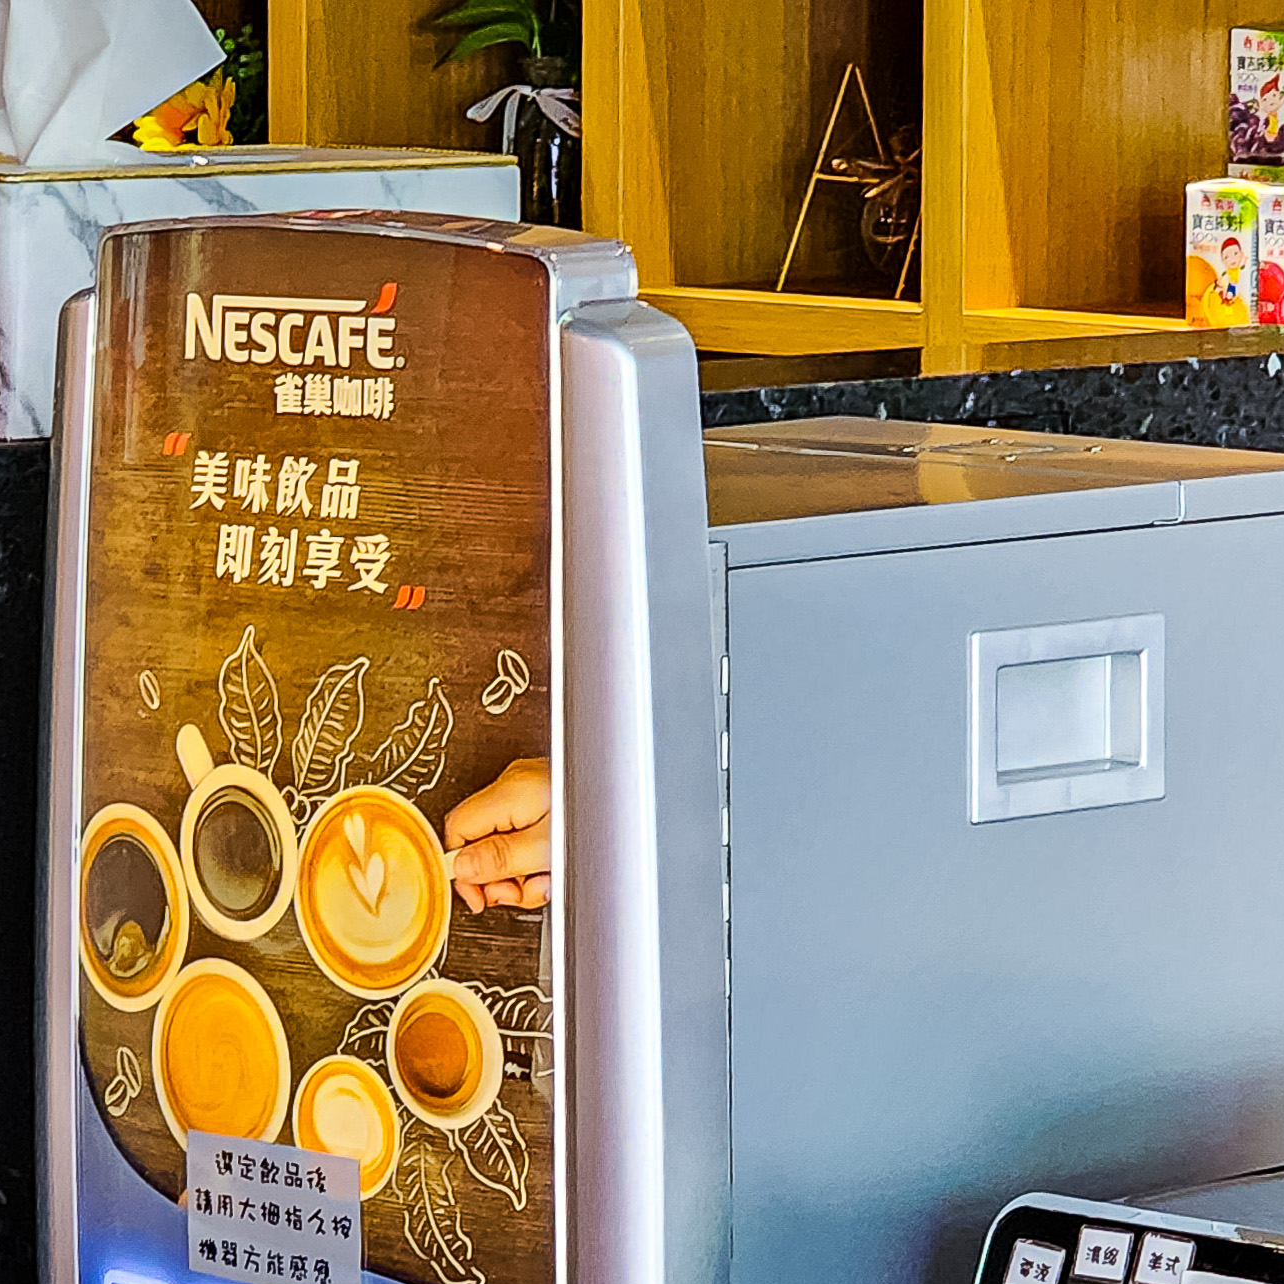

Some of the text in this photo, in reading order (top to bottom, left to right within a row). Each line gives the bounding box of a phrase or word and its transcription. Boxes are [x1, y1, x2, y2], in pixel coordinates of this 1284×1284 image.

[274, 372, 394, 420] 雀巢咖啡
[190, 450, 362, 520] 美味飲品
[217, 524, 392, 595] 即刻享受
[215, 1150, 327, 1194] 選定飲品後
[195, 1187, 353, 1240] 請用大拇指久按
